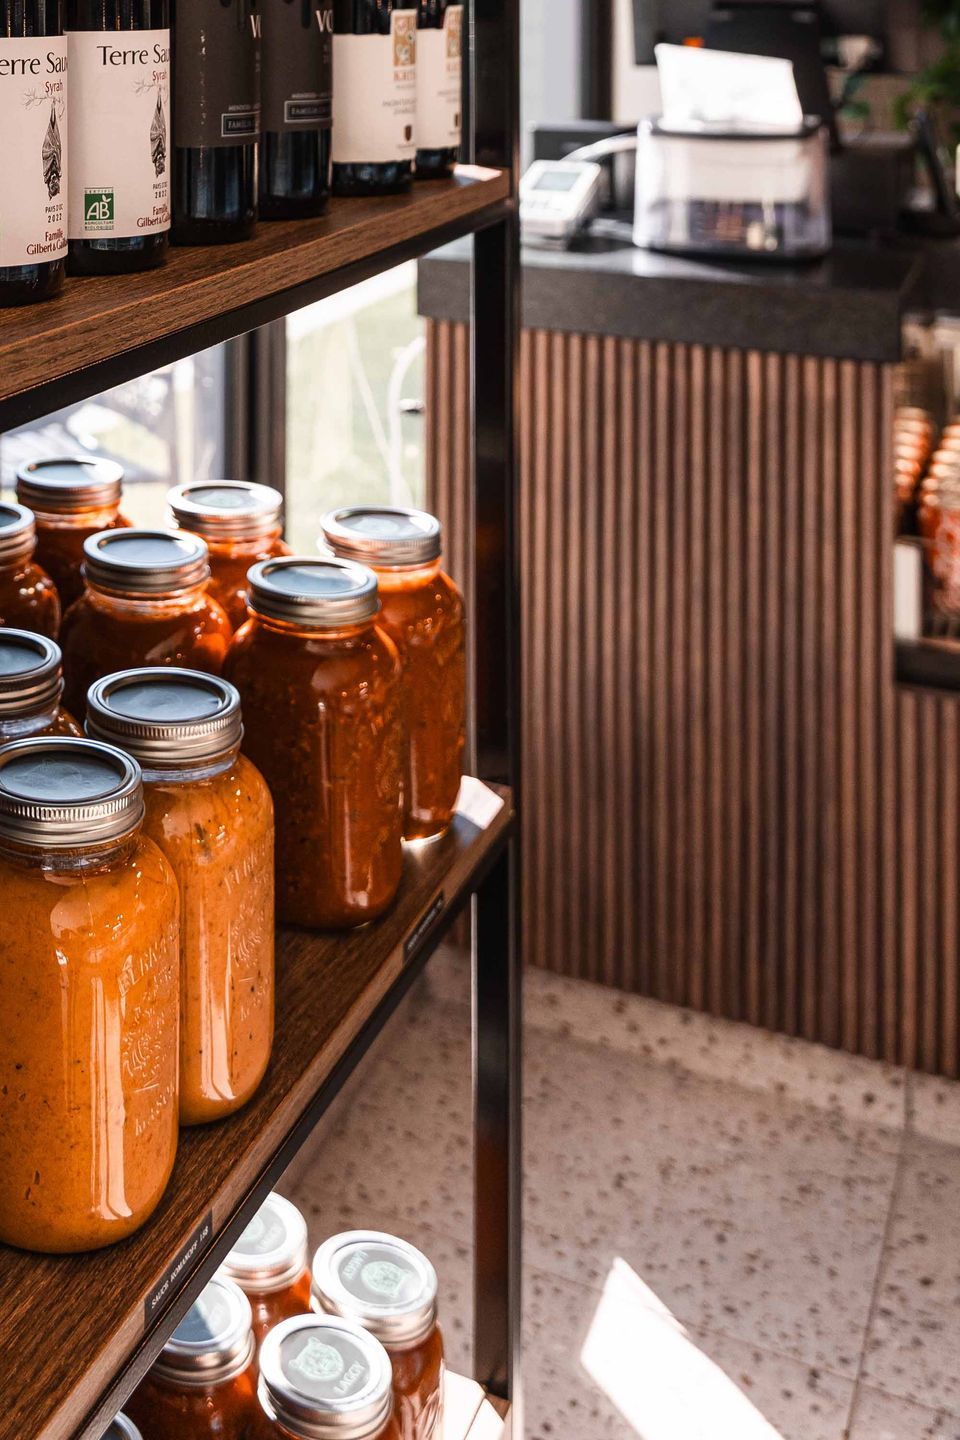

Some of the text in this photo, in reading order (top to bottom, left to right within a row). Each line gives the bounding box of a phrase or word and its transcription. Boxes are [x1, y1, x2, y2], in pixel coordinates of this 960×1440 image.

[96, 45, 149, 66] Terre
[45, 81, 63, 95] Syrah
[87, 202, 110, 220] AB
[137, 214, 159, 227] Gilbert
[27, 242, 52, 255] Gilbert
[151, 1279, 169, 1309] SAUCE
[334, 1361, 366, 1395] LAGGY
